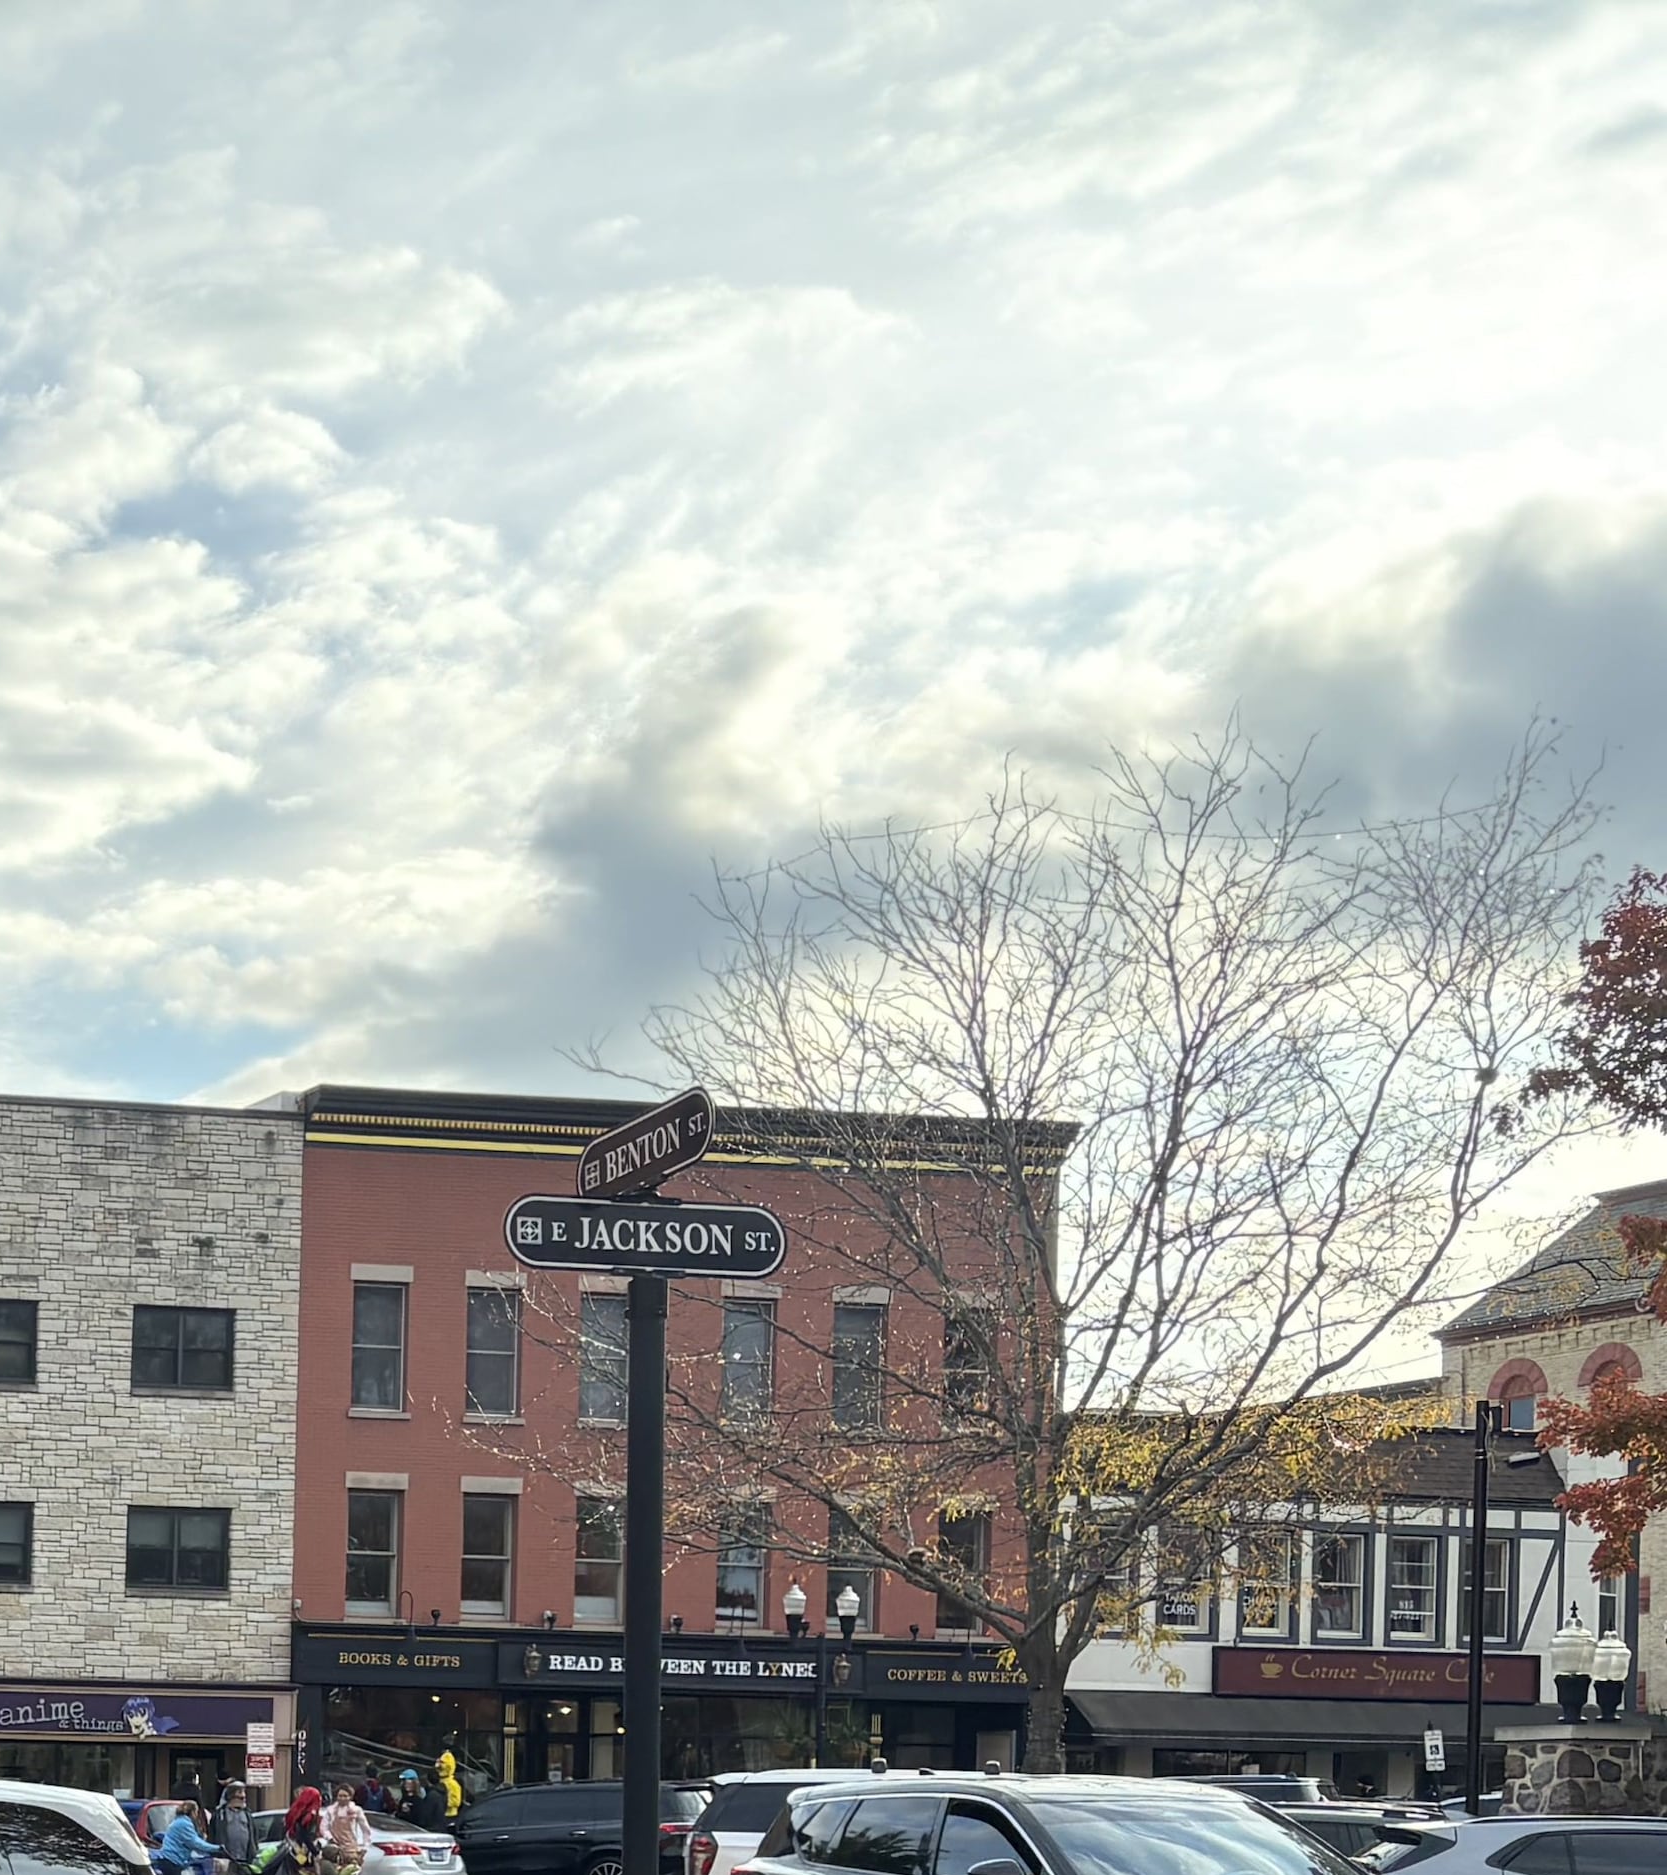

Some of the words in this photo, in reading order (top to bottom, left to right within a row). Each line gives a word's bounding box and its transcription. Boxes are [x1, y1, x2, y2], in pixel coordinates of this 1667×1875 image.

[604, 1117, 682, 1184] BENTON
[688, 1111, 708, 1137] ST.
[551, 1222, 567, 1241] E
[574, 1216, 734, 1256] JACKSON
[744, 1231, 776, 1252] ST.
[1163, 1604, 1196, 1616] CARDS
[339, 1652, 391, 1665] BOOKS
[396, 1654, 409, 1666] &
[414, 1655, 460, 1668] GIFTS
[549, 1654, 604, 1671] READ
[712, 1660, 751, 1676] THE
[1291, 1654, 1358, 1679] Corner
[1364, 1656, 1436, 1687] Square
[887, 1669, 946, 1681] COFFEE
[951, 1670, 963, 1681] &
[968, 1671, 1028, 1684] SWEETS
[0, 1698, 84, 1726] anime
[72, 1717, 124, 1733] things
